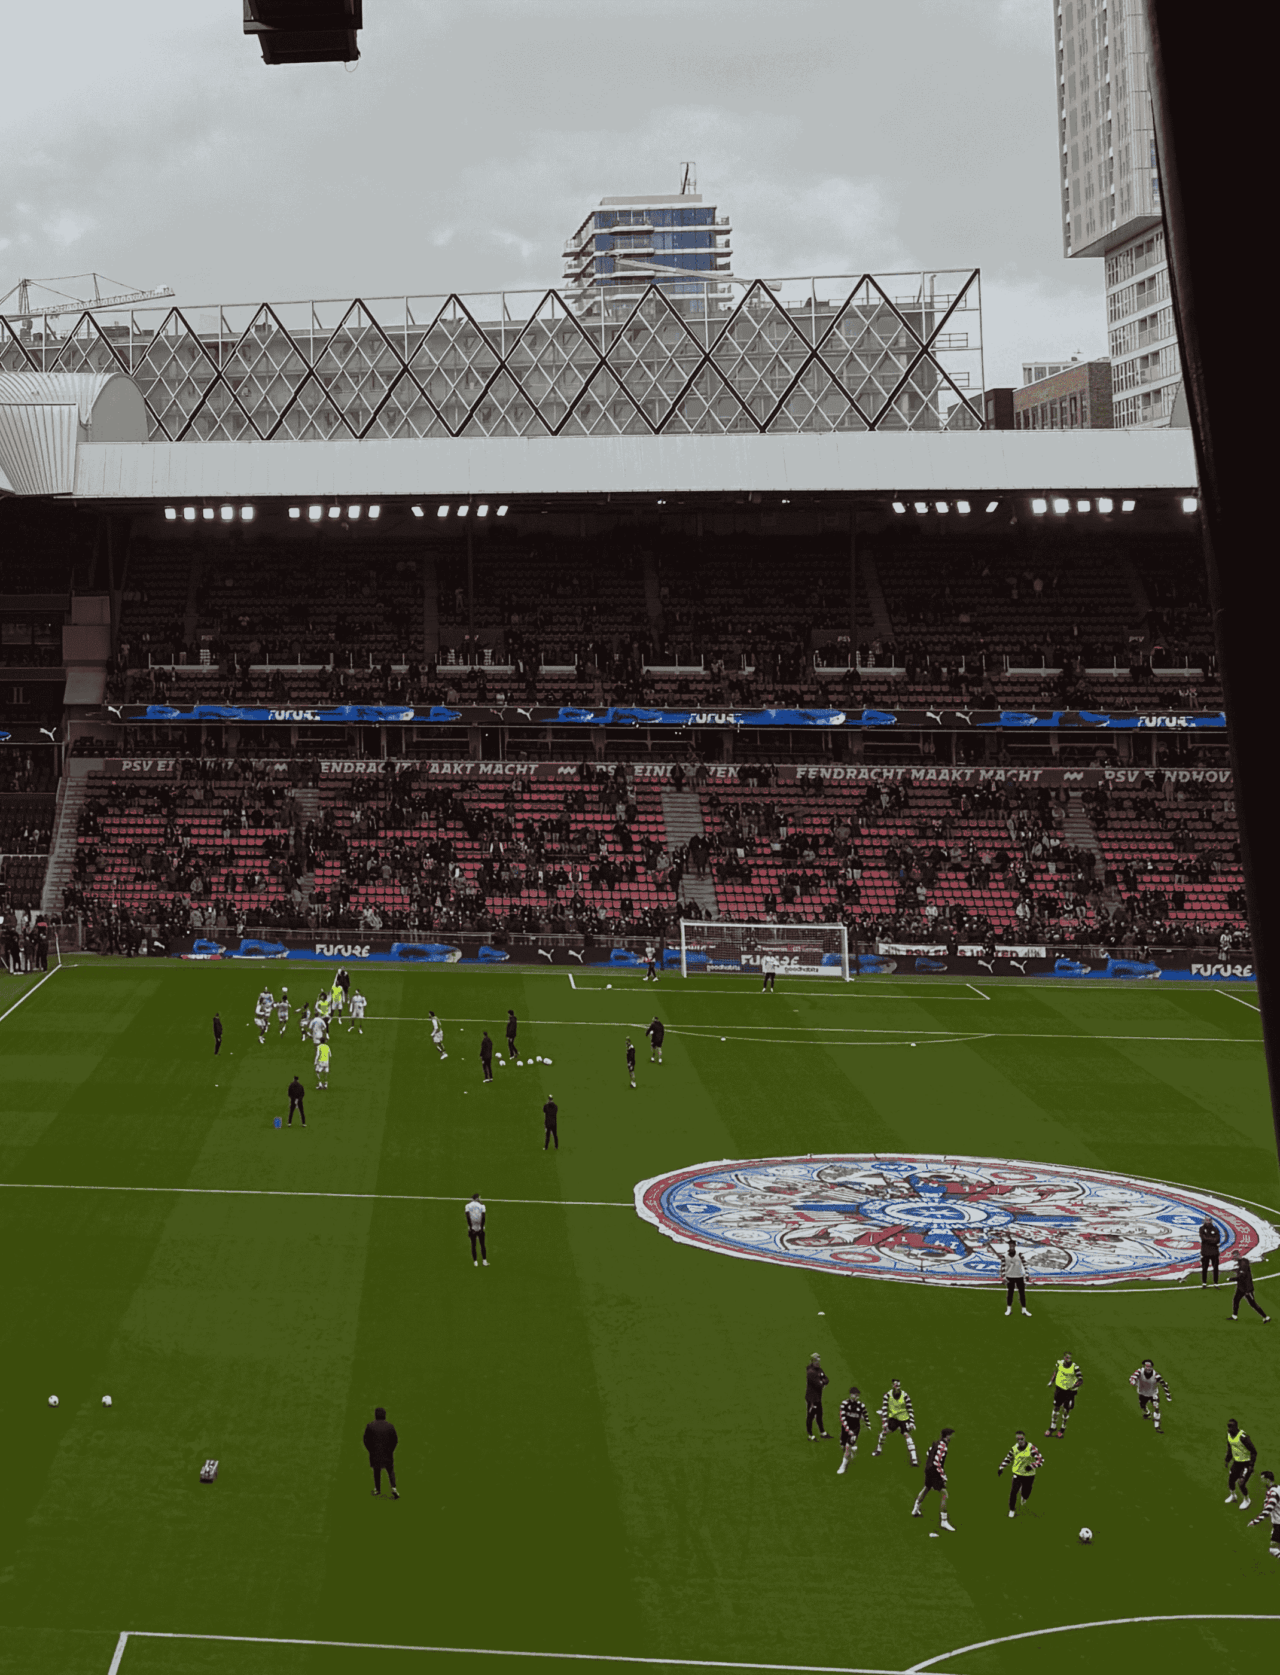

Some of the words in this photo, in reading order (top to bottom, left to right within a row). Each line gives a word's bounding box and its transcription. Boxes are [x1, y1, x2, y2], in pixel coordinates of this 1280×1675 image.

[121, 760, 154, 771] PSV
[479, 763, 539, 776] MACHT
[796, 767, 907, 780] EENDRACHT
[910, 768, 975, 781] MAAKT
[979, 769, 1043, 782] MACHT
[1104, 771, 1140, 784] PSV
[315, 943, 371, 957] FUTURE
[1191, 963, 1253, 977] FUTURE
